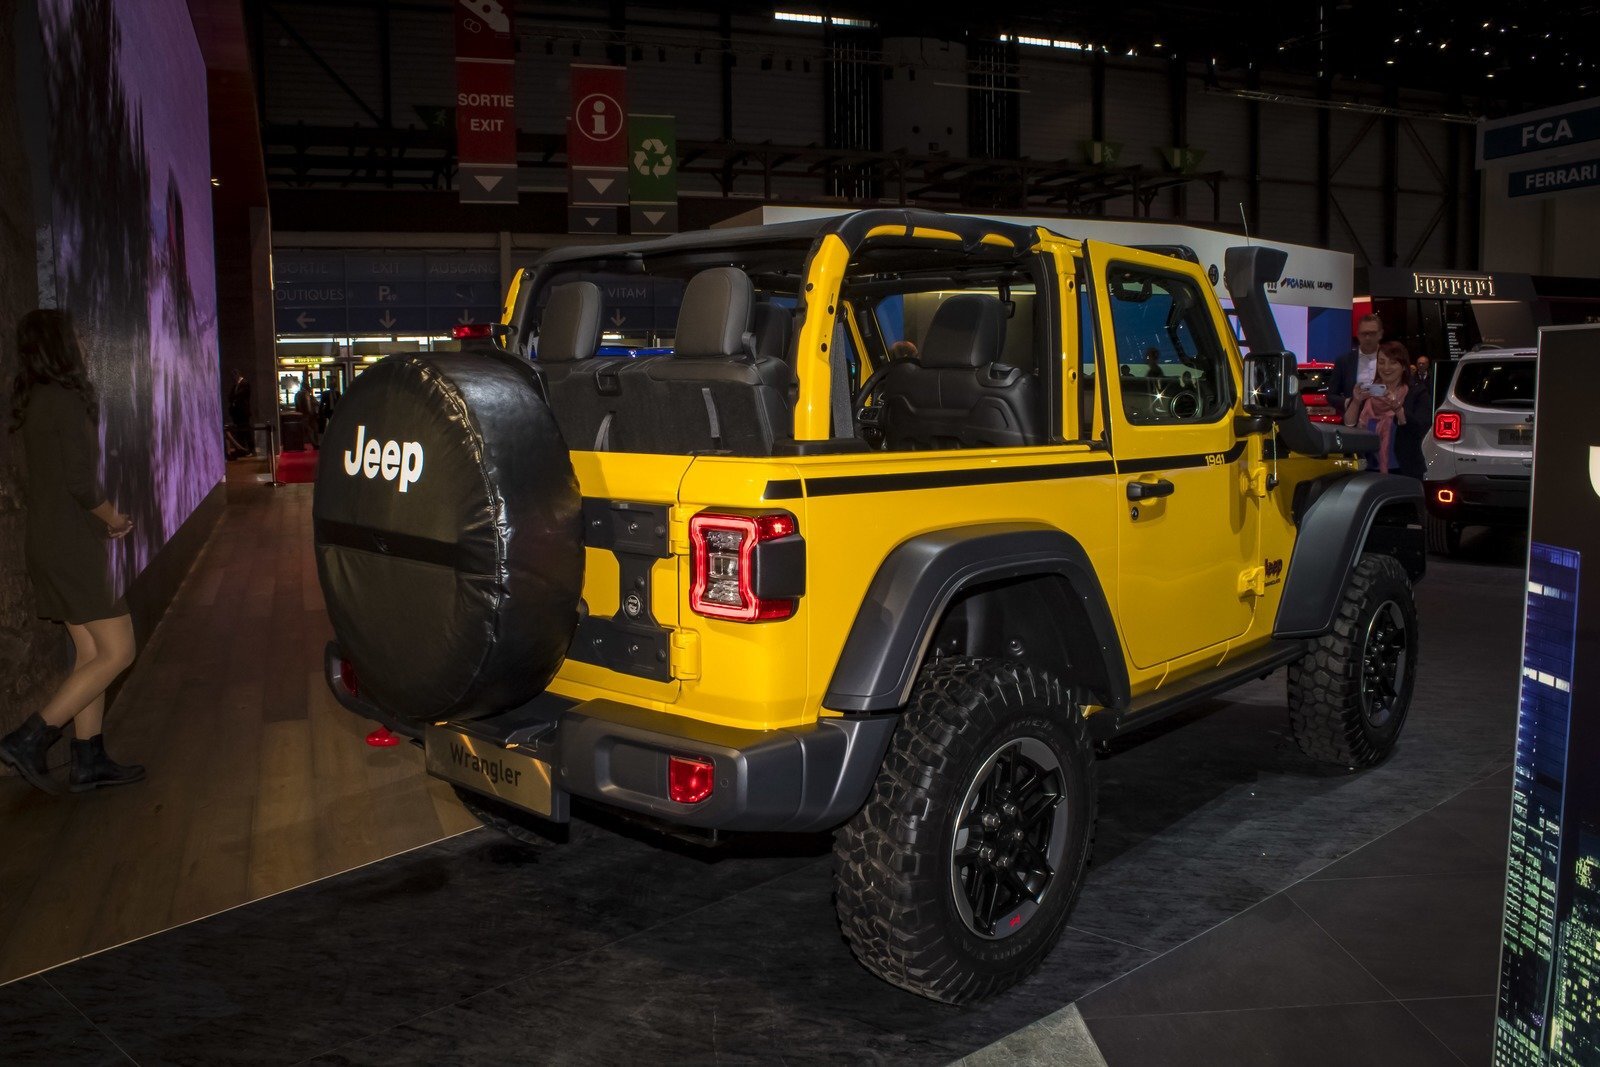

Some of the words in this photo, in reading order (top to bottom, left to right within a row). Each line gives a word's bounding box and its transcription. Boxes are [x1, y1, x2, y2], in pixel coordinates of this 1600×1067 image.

[457, 93, 515, 108] SORTIE
[470, 118, 505, 132] EXIT
[1521, 118, 1574, 147] FCA
[1525, 164, 1598, 190] FERRARI
[371, 262, 400, 274] EXIT
[1413, 272, 1496, 296] Ferrari
[275, 289, 345, 301] OUTIQUES
[608, 288, 647, 299] VITAM
[343, 425, 424, 493] Jeep
[1204, 453, 1226, 467] 1941
[450, 742, 521, 786] Wrangler
